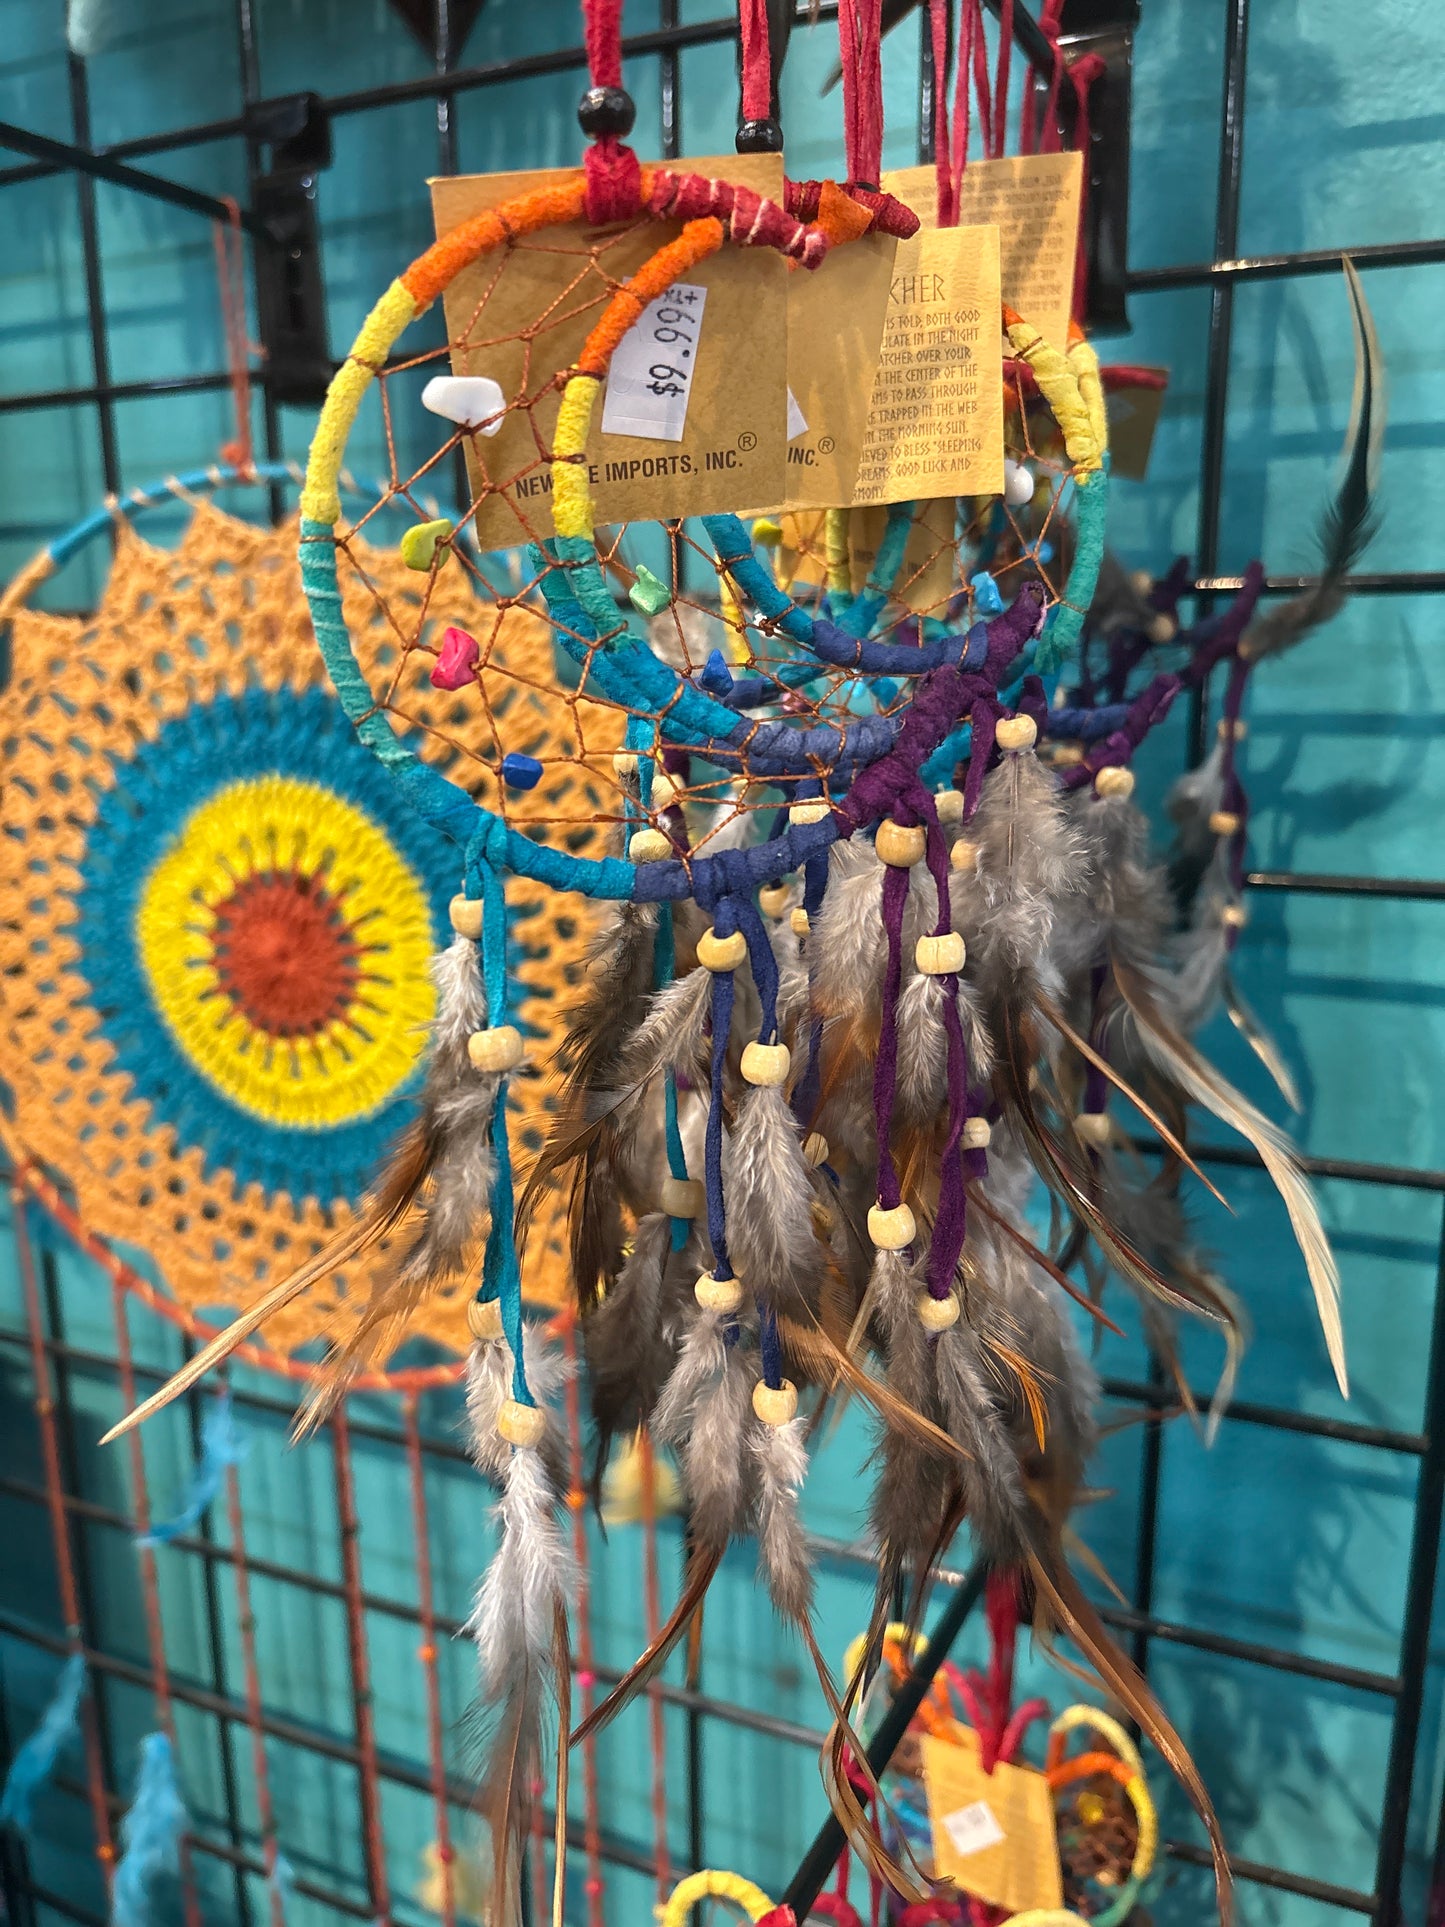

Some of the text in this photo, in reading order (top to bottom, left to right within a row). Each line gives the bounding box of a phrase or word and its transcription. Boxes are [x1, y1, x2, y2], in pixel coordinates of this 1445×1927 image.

[926, 311, 951, 327] BOTH
[954, 309, 980, 324] GOOD
[914, 332, 925, 346] IN
[928, 329, 947, 345] THE
[949, 327, 980, 343] NIGHT
[646, 307, 696, 398] $9.99
[916, 348, 942, 363] OVER
[944, 346, 972, 361] YOUR
[885, 370, 904, 385] THE
[905, 367, 941, 382] CENTER
[943, 365, 956, 380] OF
[958, 363, 978, 379] THE
[891, 389, 904, 404] TO
[905, 385, 928, 401] PASS
[931, 382, 977, 399] THROUGH
[879, 405, 920, 425] TRAPPED
[922, 403, 932, 418] IN
[936, 402, 955, 417] THE
[957, 400, 978, 416] WEB
[878, 427, 896, 442] THE
[898, 421, 943, 440] MORNING
[945, 420, 969, 435] SUN.
[889, 445, 902, 460] TO
[904, 441, 931, 458] BLESS
[605, 454, 698, 482] IMPORTS,
[896, 461, 921, 477] GOOD
[923, 459, 948, 474] LUCK
[950, 457, 972, 472] AND
